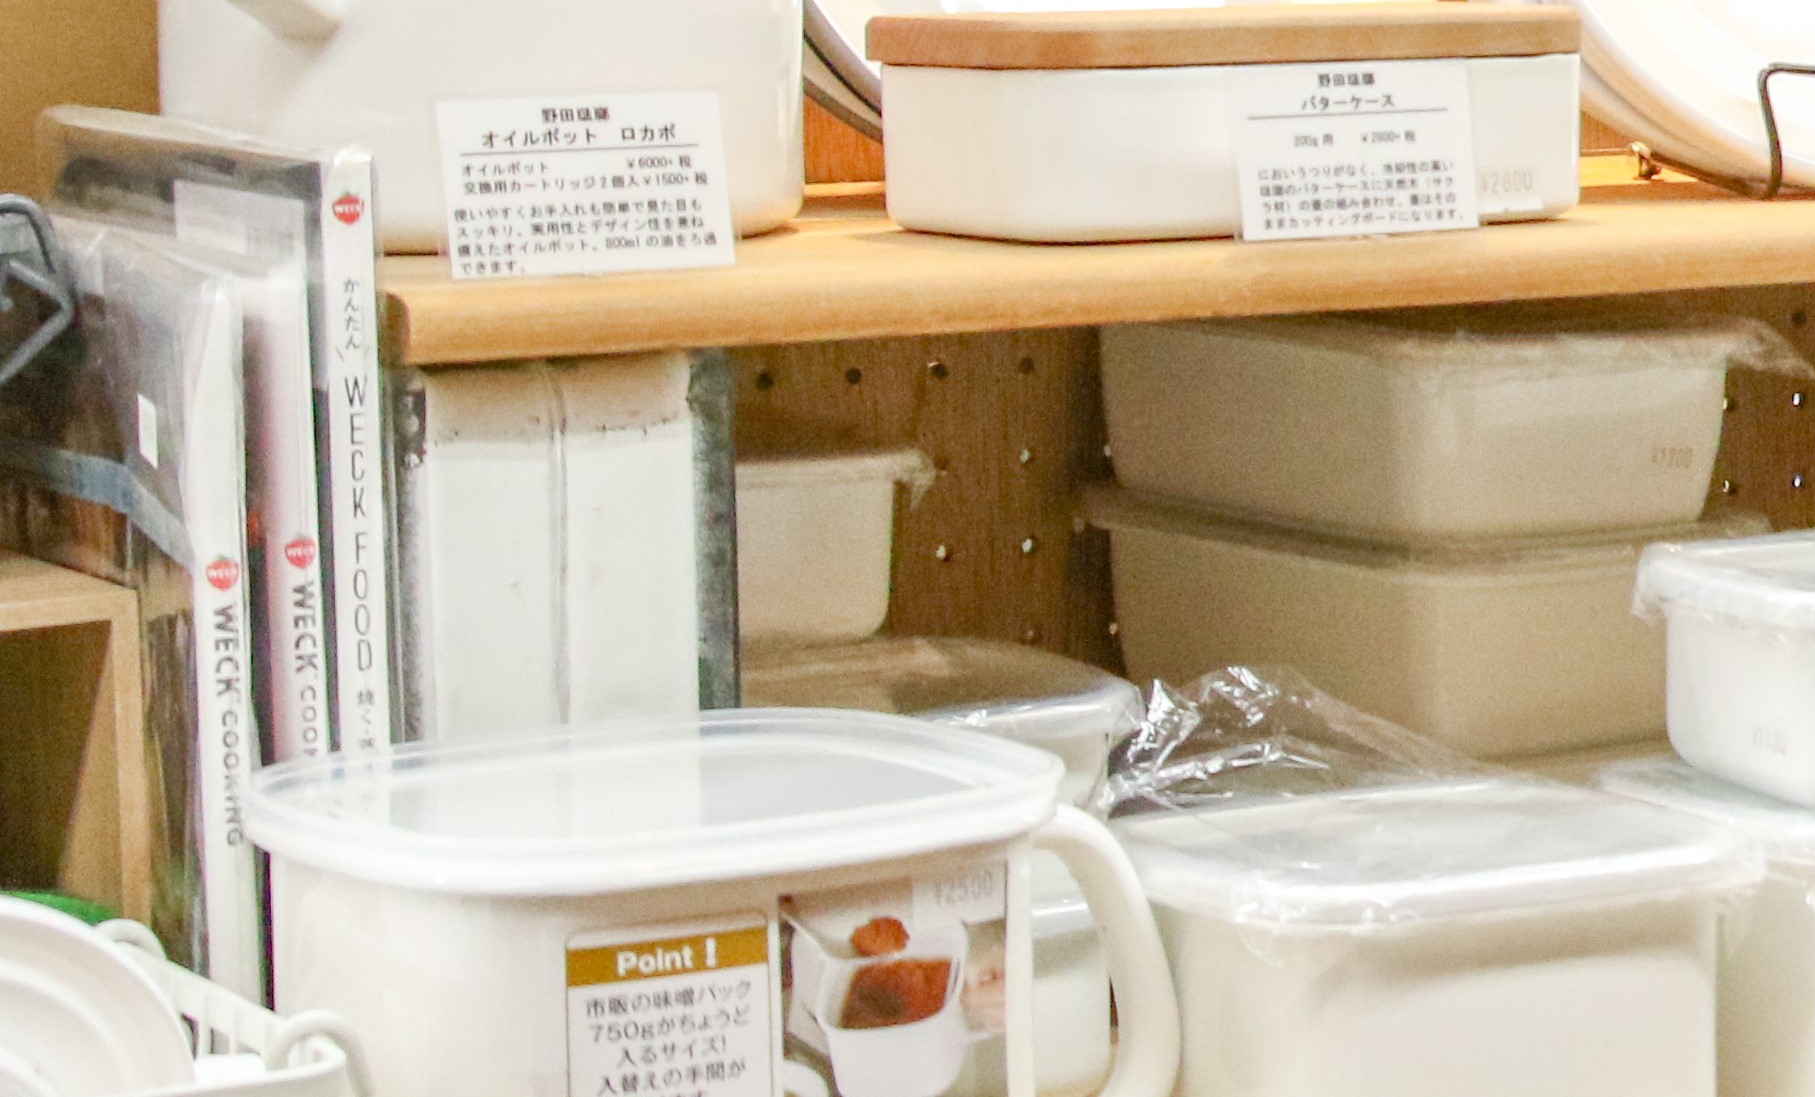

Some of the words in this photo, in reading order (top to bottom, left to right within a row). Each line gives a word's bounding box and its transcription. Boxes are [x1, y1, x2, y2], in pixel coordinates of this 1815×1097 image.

[1300, 93, 1396, 111] バターケース
[343, 278, 361, 351] かんたん
[343, 375, 368, 519] WECK
[292, 580, 319, 673] WECK
[352, 531, 374, 672] FOOD
[212, 603, 241, 699] WECK
[221, 709, 245, 847] COOKING
[585, 979, 752, 1019] 市販の味噌パック
[589, 1004, 751, 1043] 750gがちょうど
[596, 1057, 748, 1096] 入替えの手間が
